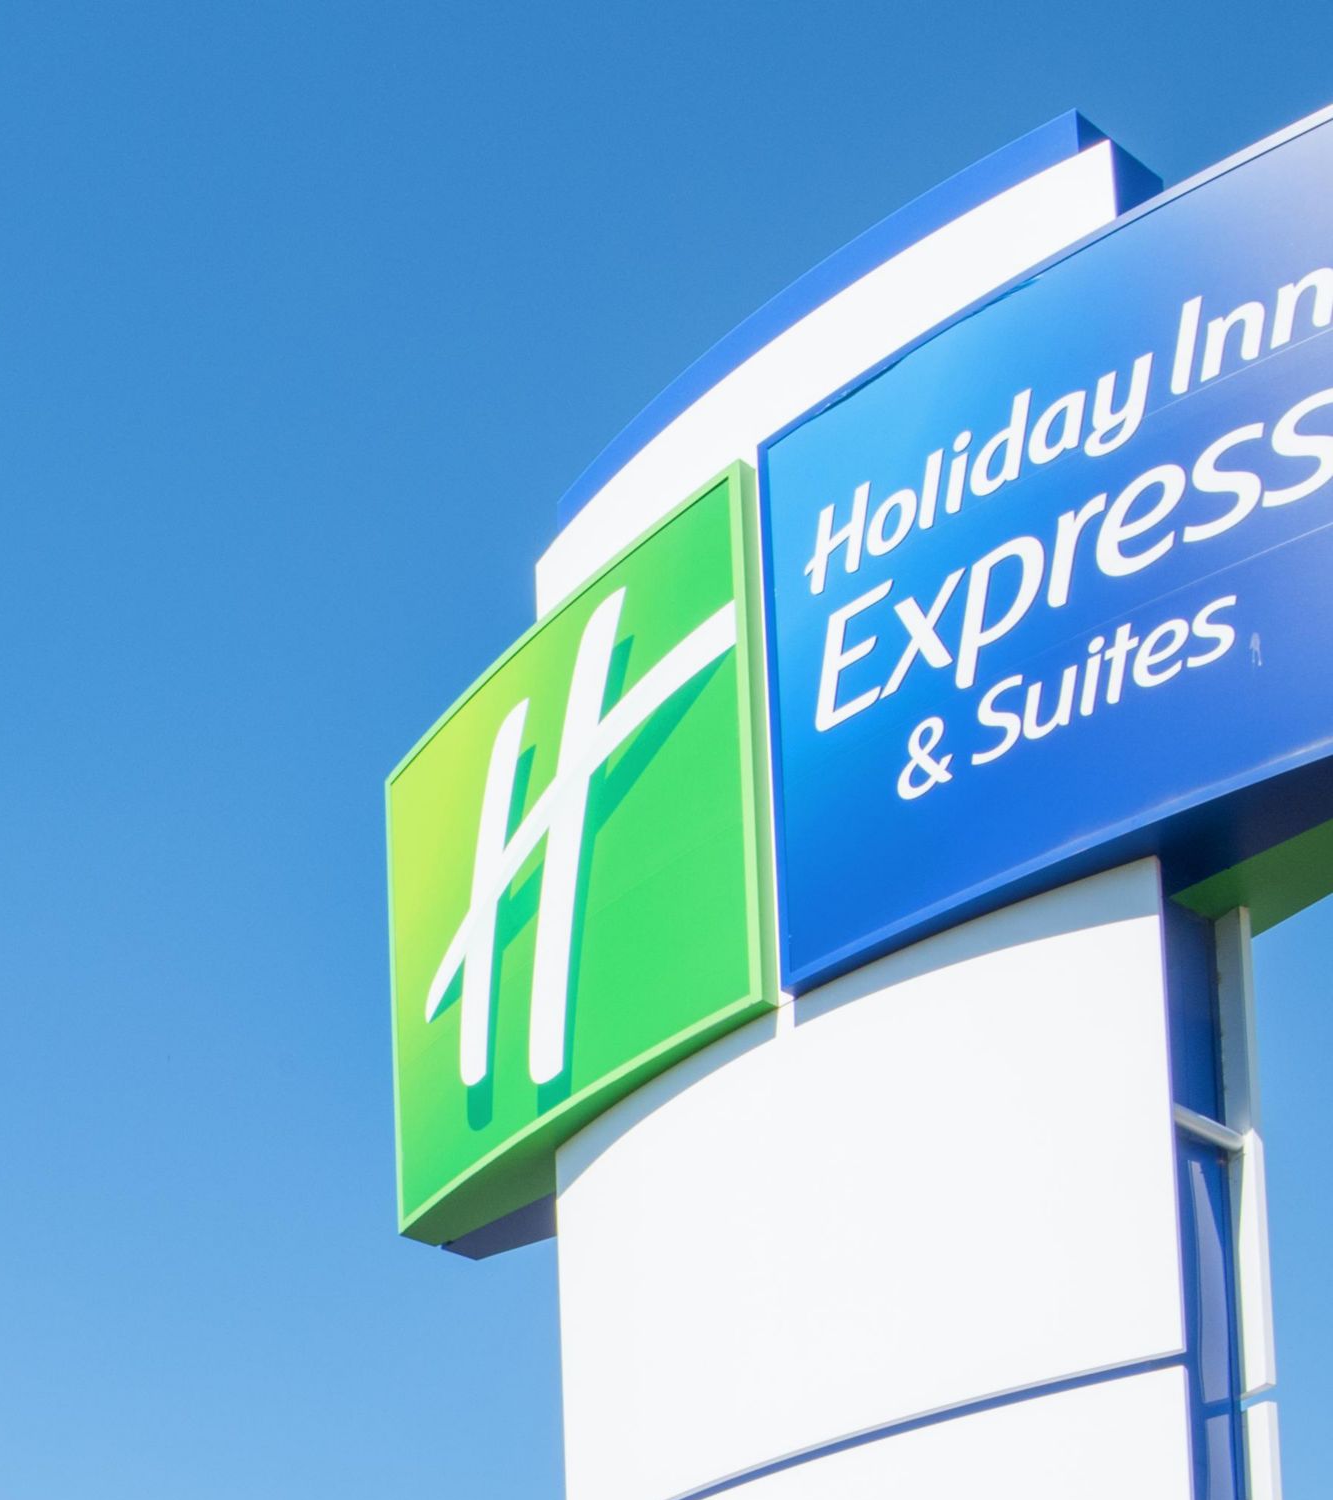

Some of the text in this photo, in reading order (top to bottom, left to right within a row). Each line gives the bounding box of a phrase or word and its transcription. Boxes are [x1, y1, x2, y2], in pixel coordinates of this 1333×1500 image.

[804, 266, 1333, 595] Holiday Inn
[815, 387, 1333, 731] Express
[897, 595, 1237, 799] & Suites
